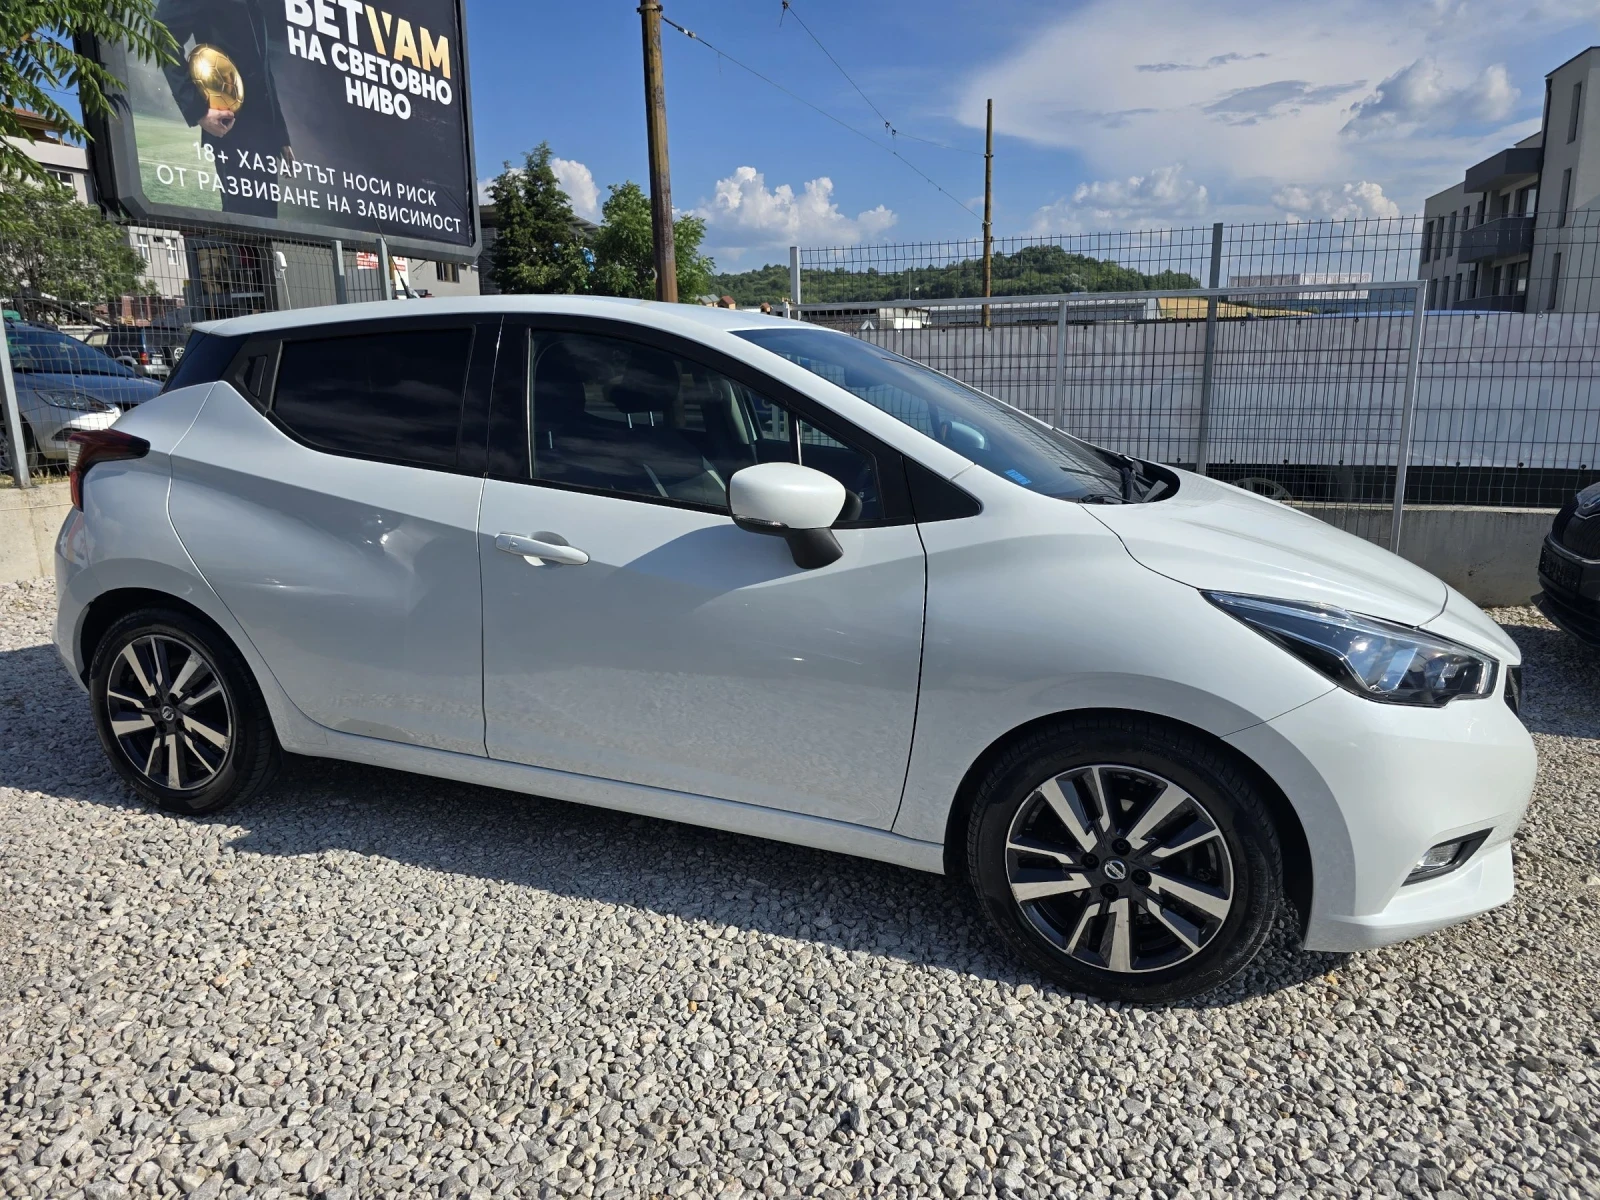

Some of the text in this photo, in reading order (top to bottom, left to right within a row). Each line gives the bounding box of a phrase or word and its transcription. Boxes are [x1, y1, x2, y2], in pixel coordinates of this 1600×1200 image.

[287, 25, 453, 105] НА СВЕТОВНО
[345, 76, 412, 120] НИВО
[156, 164, 461, 234] ОТ РАЗВИВАНЕ НА ЗАВИСИМОСТ
[193, 141, 437, 207] 18+ ХАЗАРТЪТ НОСИ РИСК
